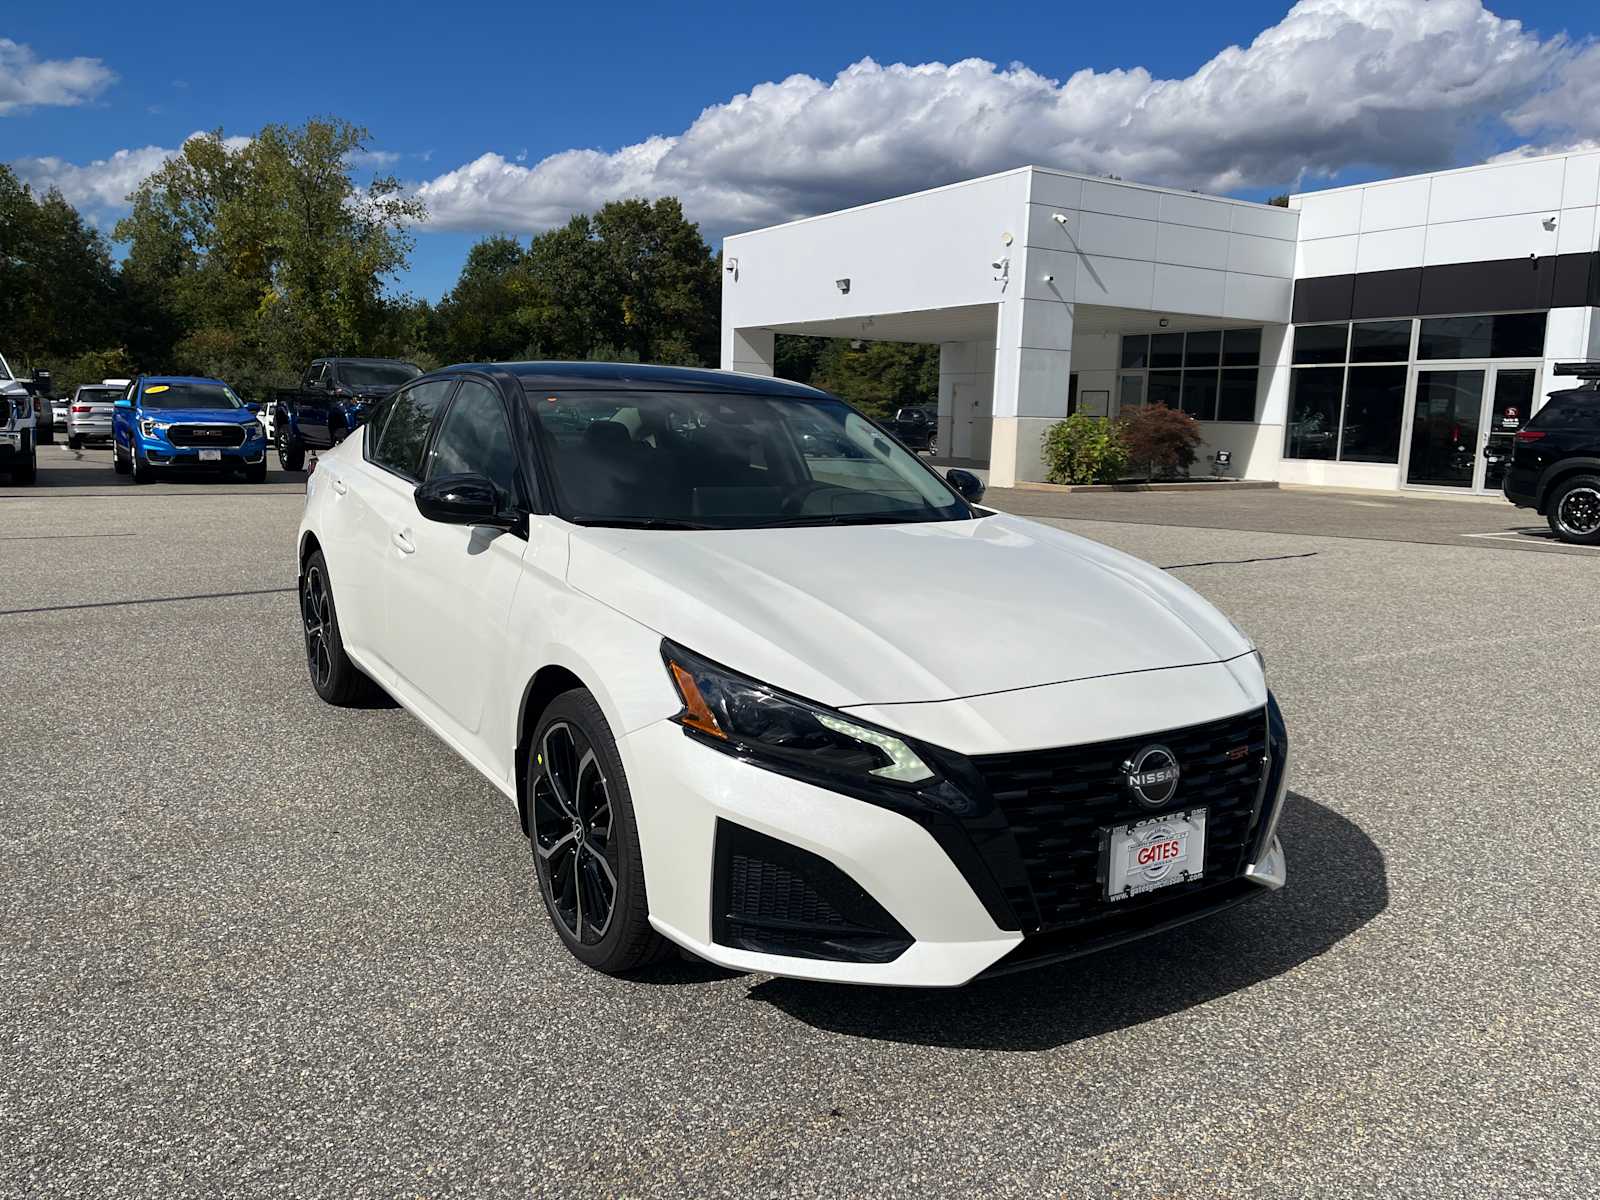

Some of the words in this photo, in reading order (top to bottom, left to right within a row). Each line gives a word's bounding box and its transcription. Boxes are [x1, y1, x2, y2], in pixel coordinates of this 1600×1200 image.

[1129, 768, 1179, 786] NISSAN
[1135, 812, 1185, 827] GATES
[1138, 841, 1180, 865] GATES
